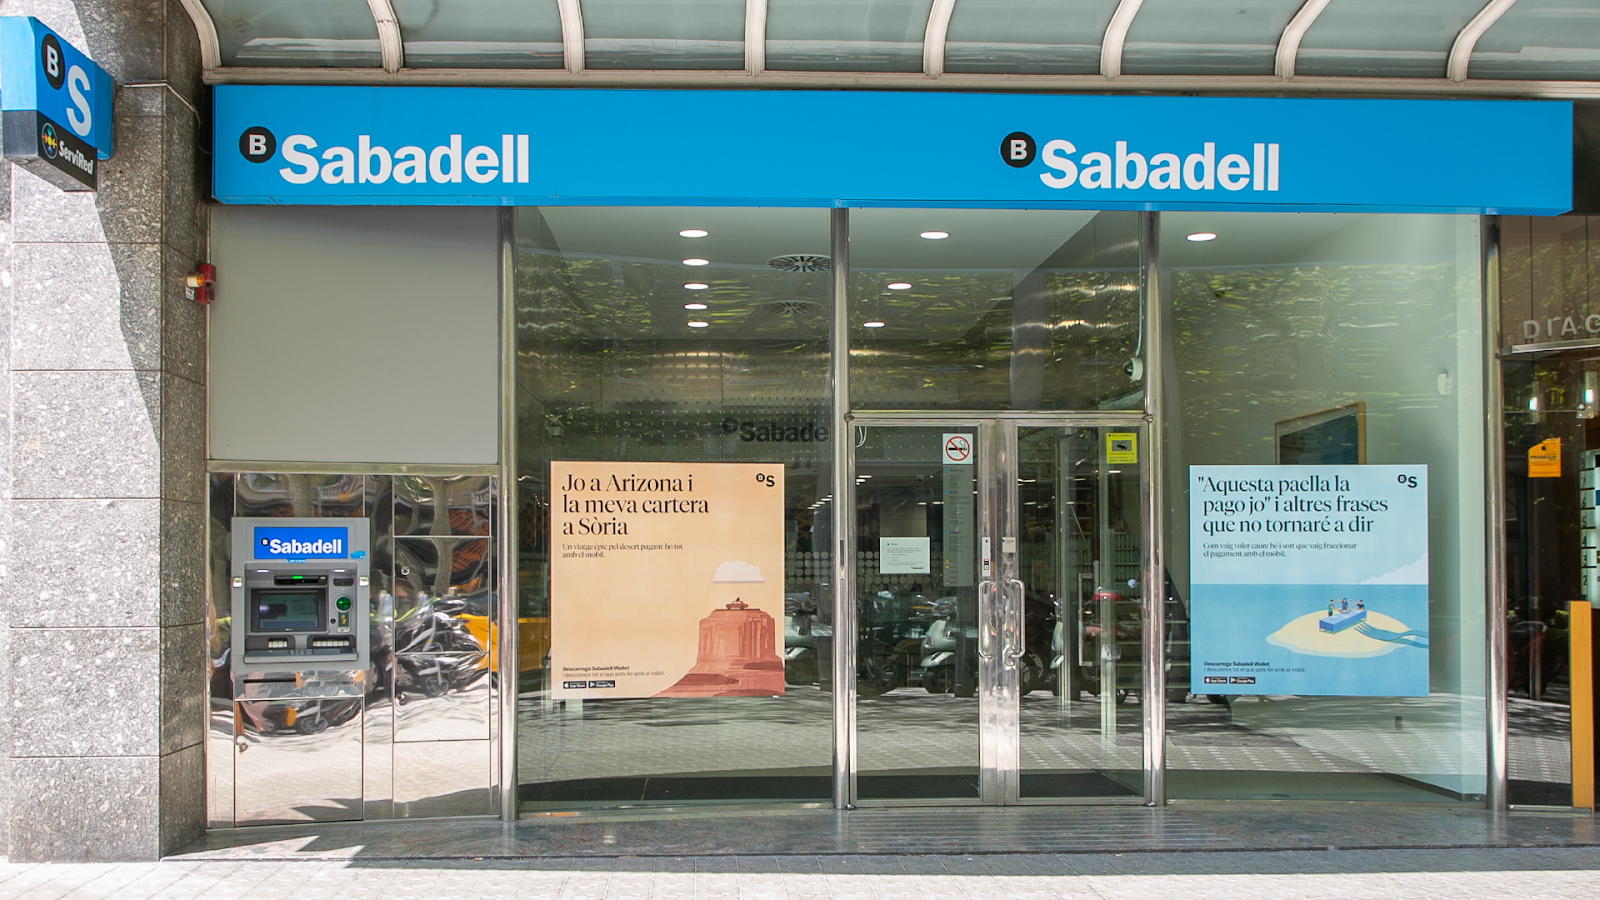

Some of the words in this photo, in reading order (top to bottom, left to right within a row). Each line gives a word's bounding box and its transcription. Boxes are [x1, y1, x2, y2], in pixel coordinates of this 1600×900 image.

[46, 44, 59, 78] B
[66, 64, 92, 137] S
[58, 140, 94, 176] ServiRed
[249, 134, 267, 155] B
[279, 134, 529, 185] Sabadell
[1010, 139, 1027, 160] B
[1039, 139, 1280, 192] Sabadell
[562, 474, 586, 492] Jo
[590, 478, 601, 492] a
[605, 474, 683, 492] Arizona
[688, 474, 693, 492] i
[766, 475, 775, 487] S
[1198, 476, 1274, 496] "Aquesta
[1278, 475, 1331, 496] paella
[1334, 475, 1350, 492] la
[1407, 476, 1418, 488] S
[563, 494, 580, 513] la
[585, 499, 638, 513] meva
[642, 497, 709, 513] cartera
[1203, 499, 1246, 516] pago
[1248, 496, 1271, 515] jo"
[1274, 496, 1279, 512] i
[1283, 495, 1332, 512] altres
[1336, 495, 1388, 512] frases
[563, 521, 574, 535] a
[578, 516, 628, 536] Sòria
[1203, 520, 1235, 536] que
[1239, 520, 1262, 533] no
[1266, 516, 1331, 533] tornaré
[1334, 520, 1344, 533] a
[1348, 516, 1374, 533] dir
[269, 539, 342, 554] Sabadell
[573, 543, 594, 552] viatge
[608, 543, 619, 552] pel
[1210, 551, 1242, 559] pagament
[1220, 542, 1234, 551] vaig
[1295, 543, 1309, 551] que
[1309, 542, 1323, 551] vaig
[1583, 575, 1588, 586] 2
